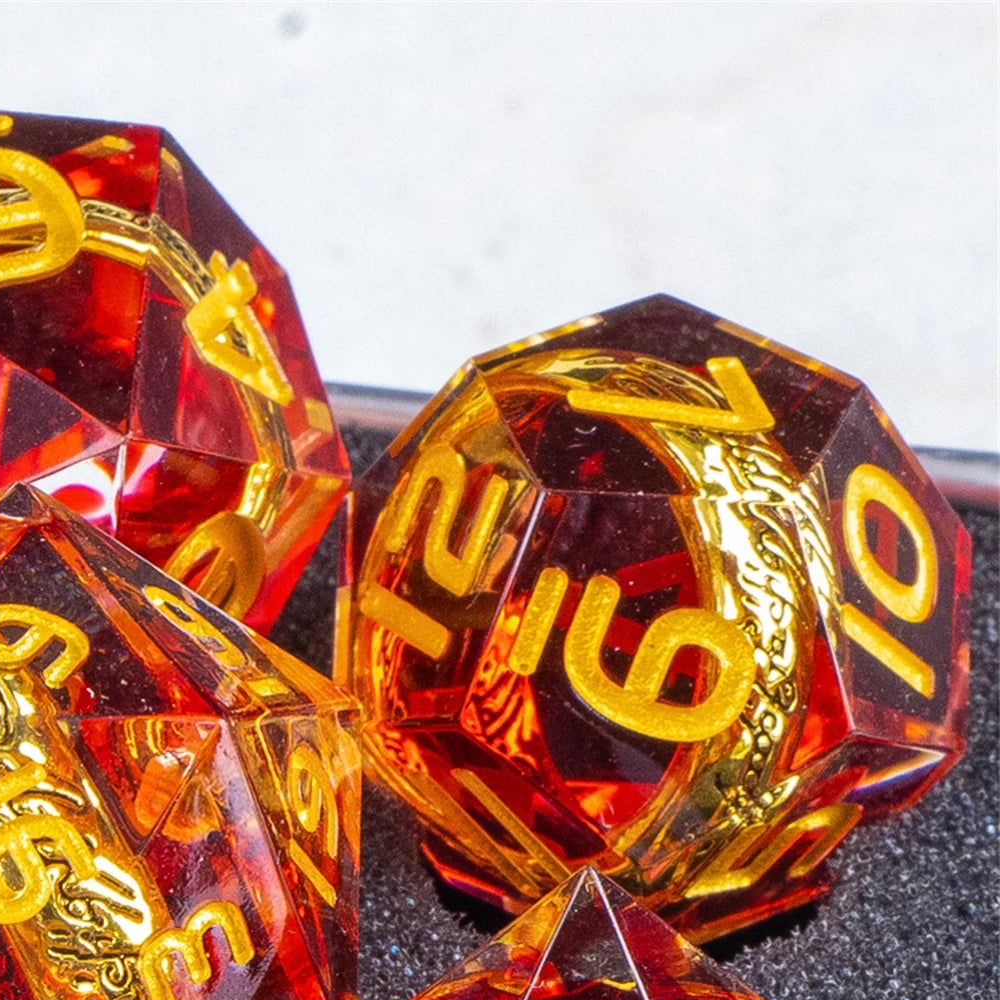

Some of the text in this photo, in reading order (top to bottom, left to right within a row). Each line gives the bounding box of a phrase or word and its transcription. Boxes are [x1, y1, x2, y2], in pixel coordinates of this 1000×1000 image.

[182, 250, 293, 407] 4
[567, 357, 775, 433] 7
[359, 443, 509, 661] 12
[841, 463, 938, 699] 10
